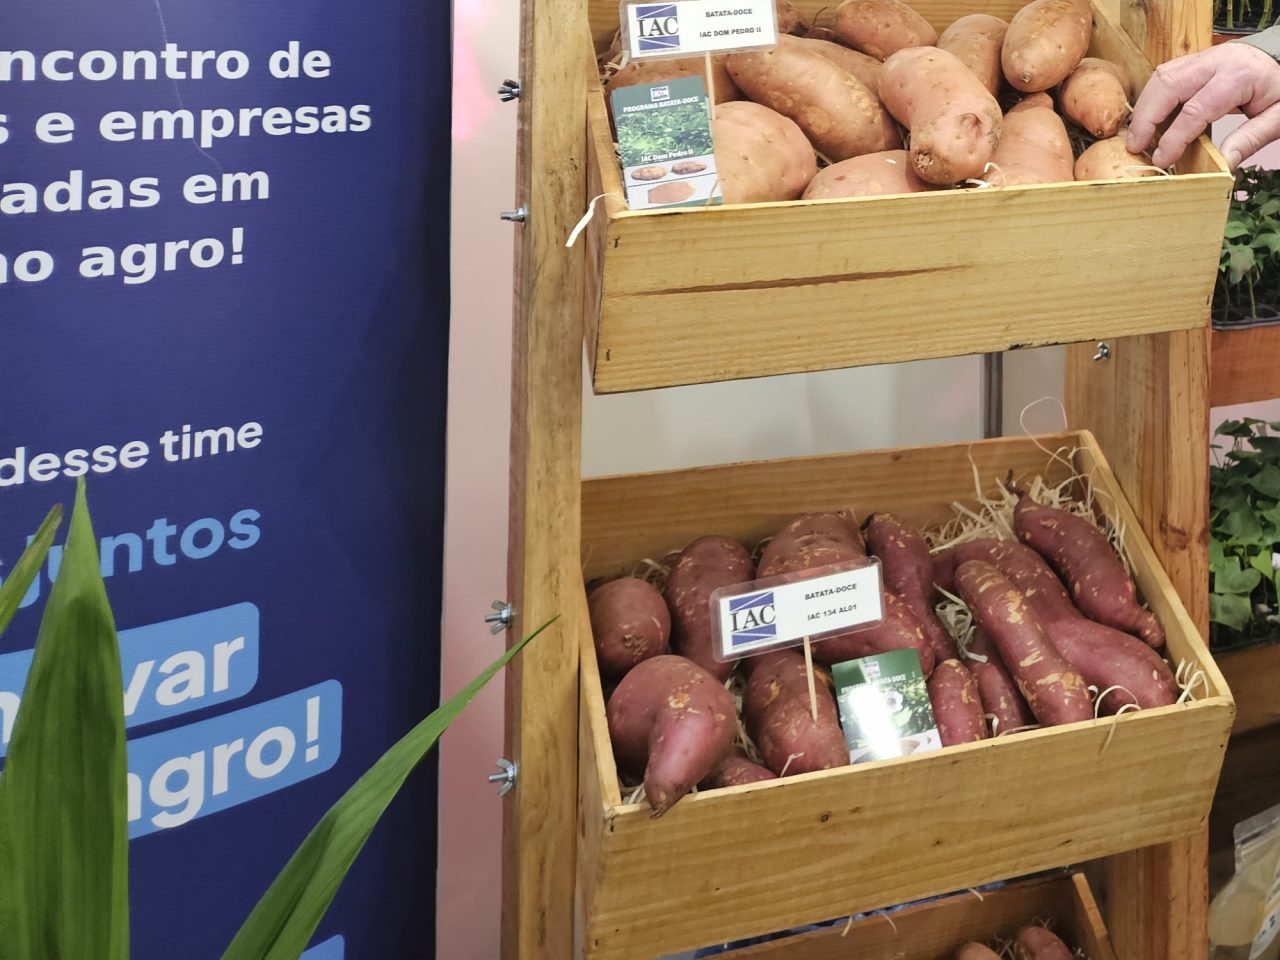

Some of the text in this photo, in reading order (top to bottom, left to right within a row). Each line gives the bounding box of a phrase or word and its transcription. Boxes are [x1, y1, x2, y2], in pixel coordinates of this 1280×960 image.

[705, 8, 753, 18] BATATA-DOCE
[636, 16, 679, 38] IAC
[714, 29, 730, 37] DOM
[731, 27, 755, 36] PEDRO
[268, 40, 331, 80] de
[623, 103, 659, 114] PROGRAMA
[35, 110, 75, 145] e
[99, 103, 373, 149] empresas
[0, 169, 271, 216] adas em
[0, 227, 245, 285] o agro!
[0, 421, 264, 488] desse time
[804, 583, 858, 601] BATATA-DOCE
[730, 604, 777, 632] IAC
[807, 604, 858, 622] IAC 134 AL01
